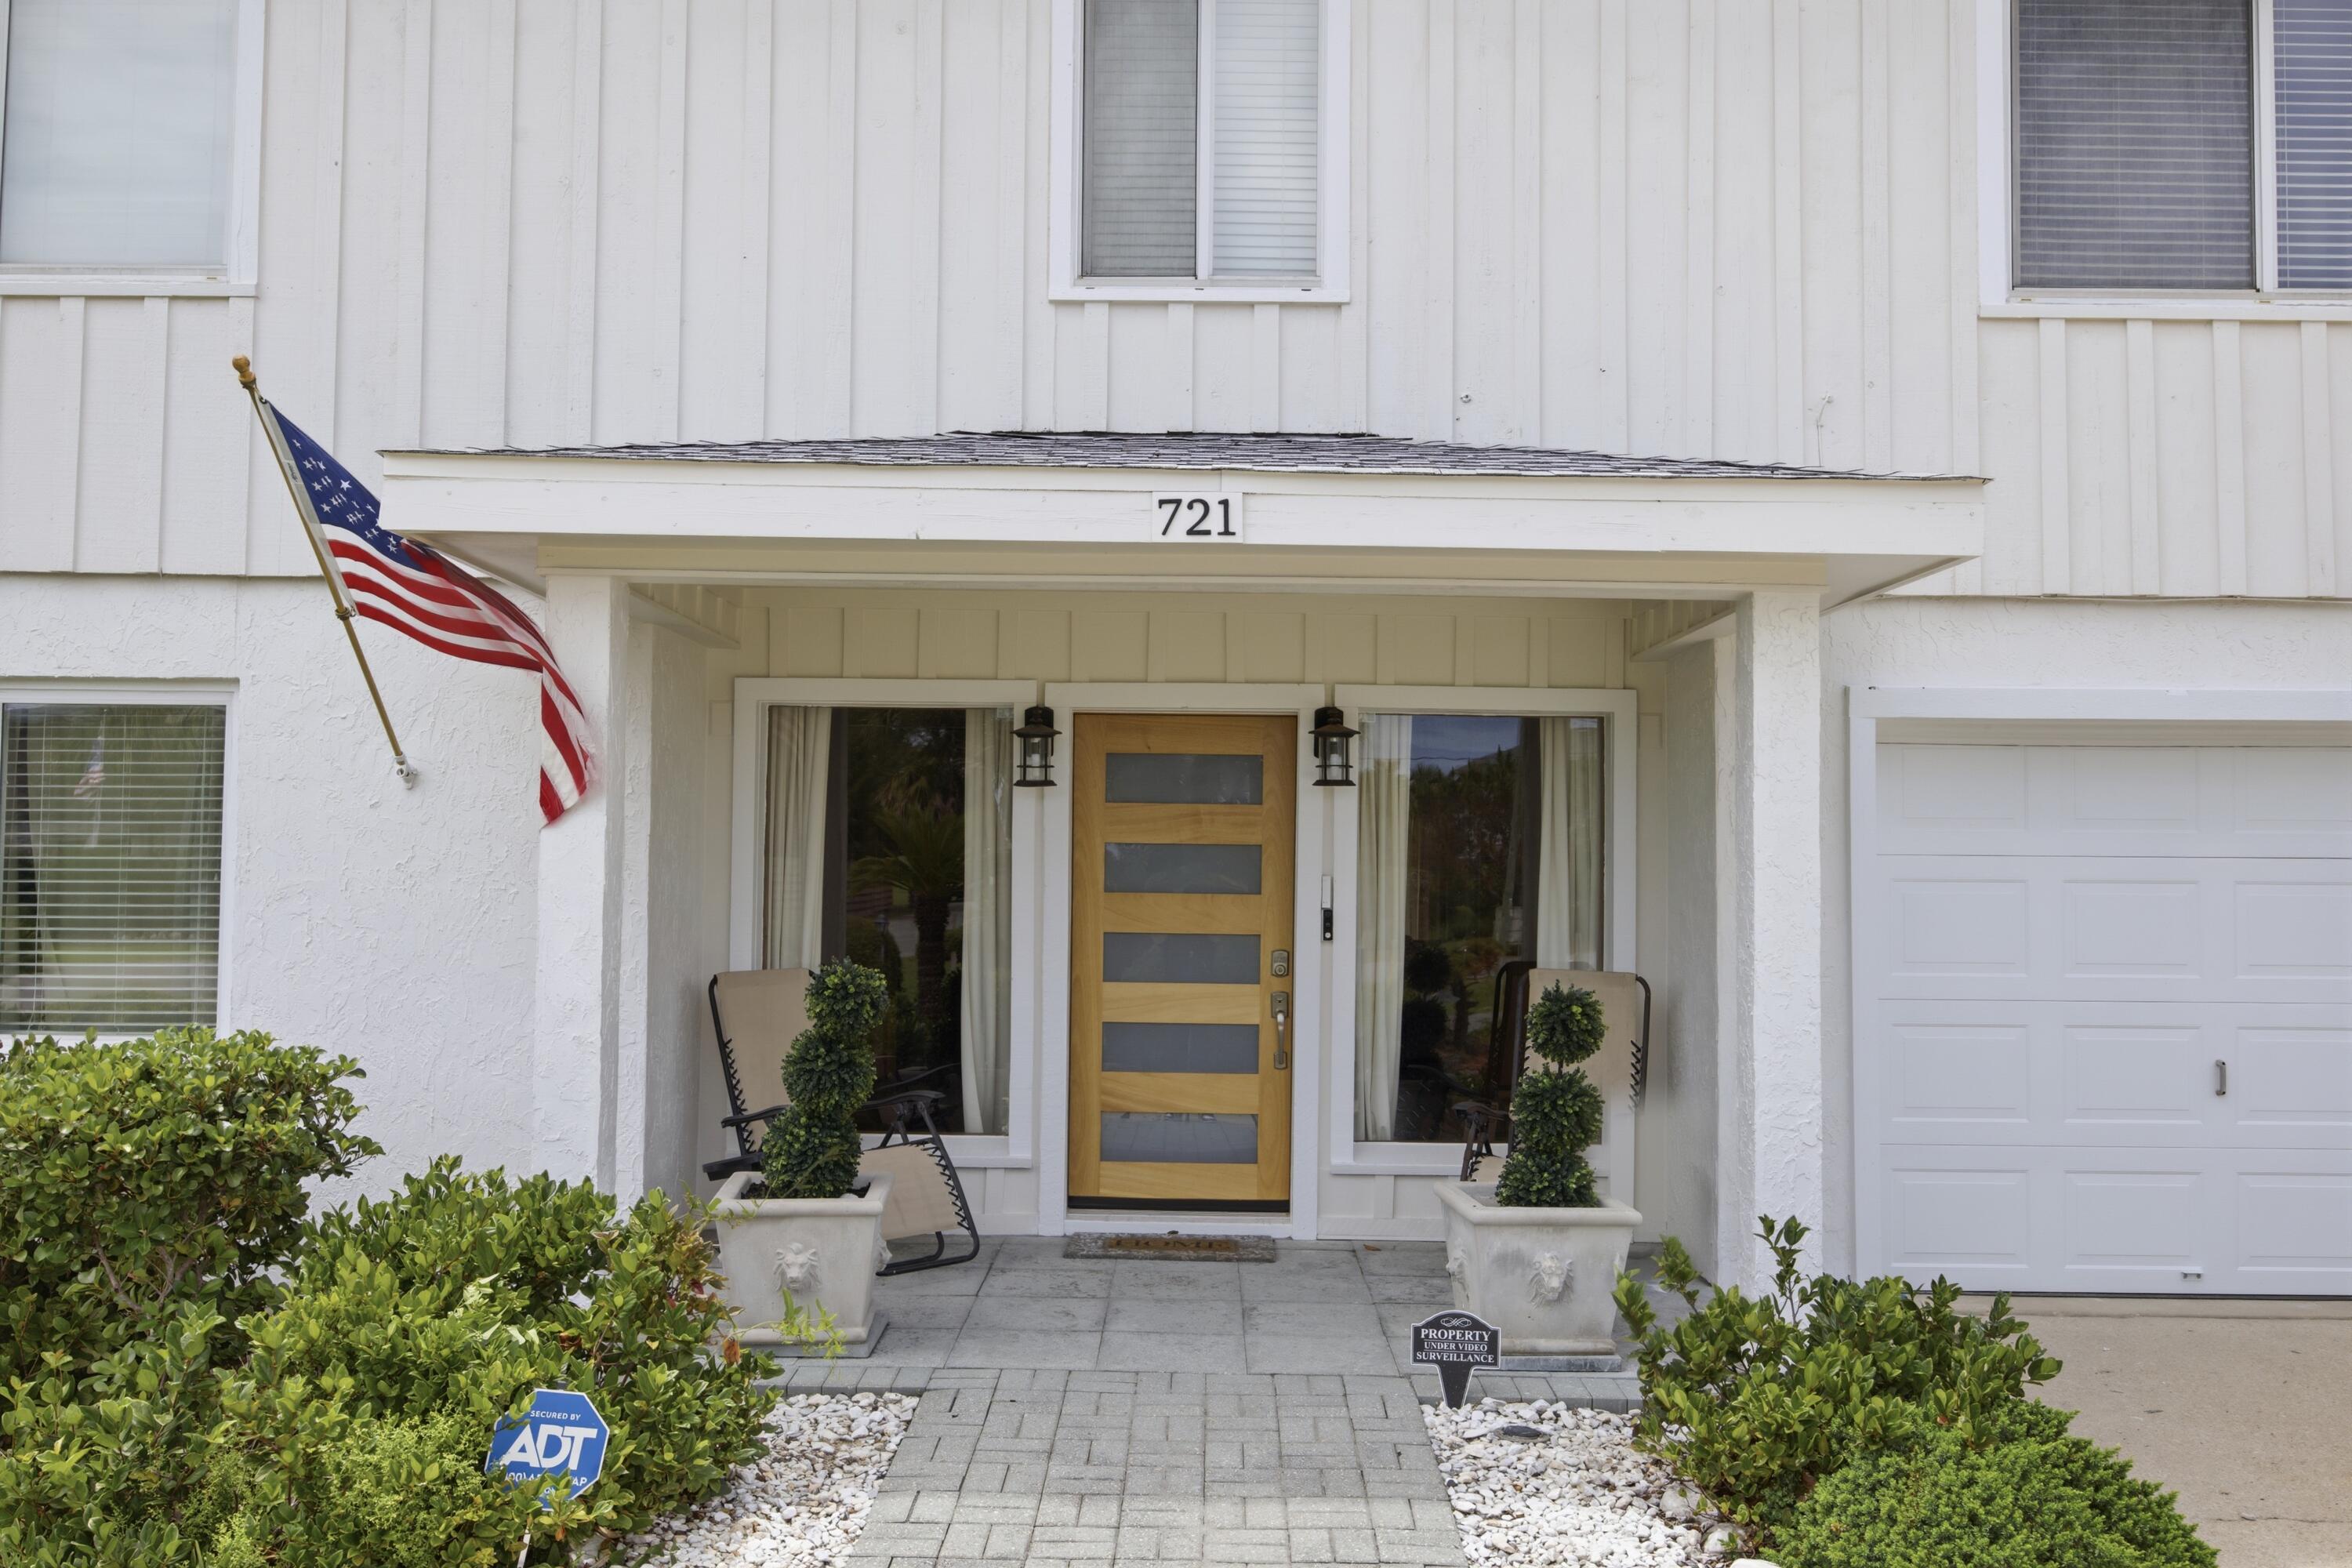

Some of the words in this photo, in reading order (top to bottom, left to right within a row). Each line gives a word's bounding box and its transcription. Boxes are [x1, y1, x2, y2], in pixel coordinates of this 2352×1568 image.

[1158, 498, 1236, 535] 721
[1420, 1328, 1491, 1341] PROPERTY
[1424, 1341, 1456, 1350] UNDER
[1457, 1343, 1487, 1352] VIDEO
[1416, 1351, 1494, 1363] SURVEILLANCE
[530, 1410, 568, 1420] SECURED
[499, 1424, 598, 1471] ADT
